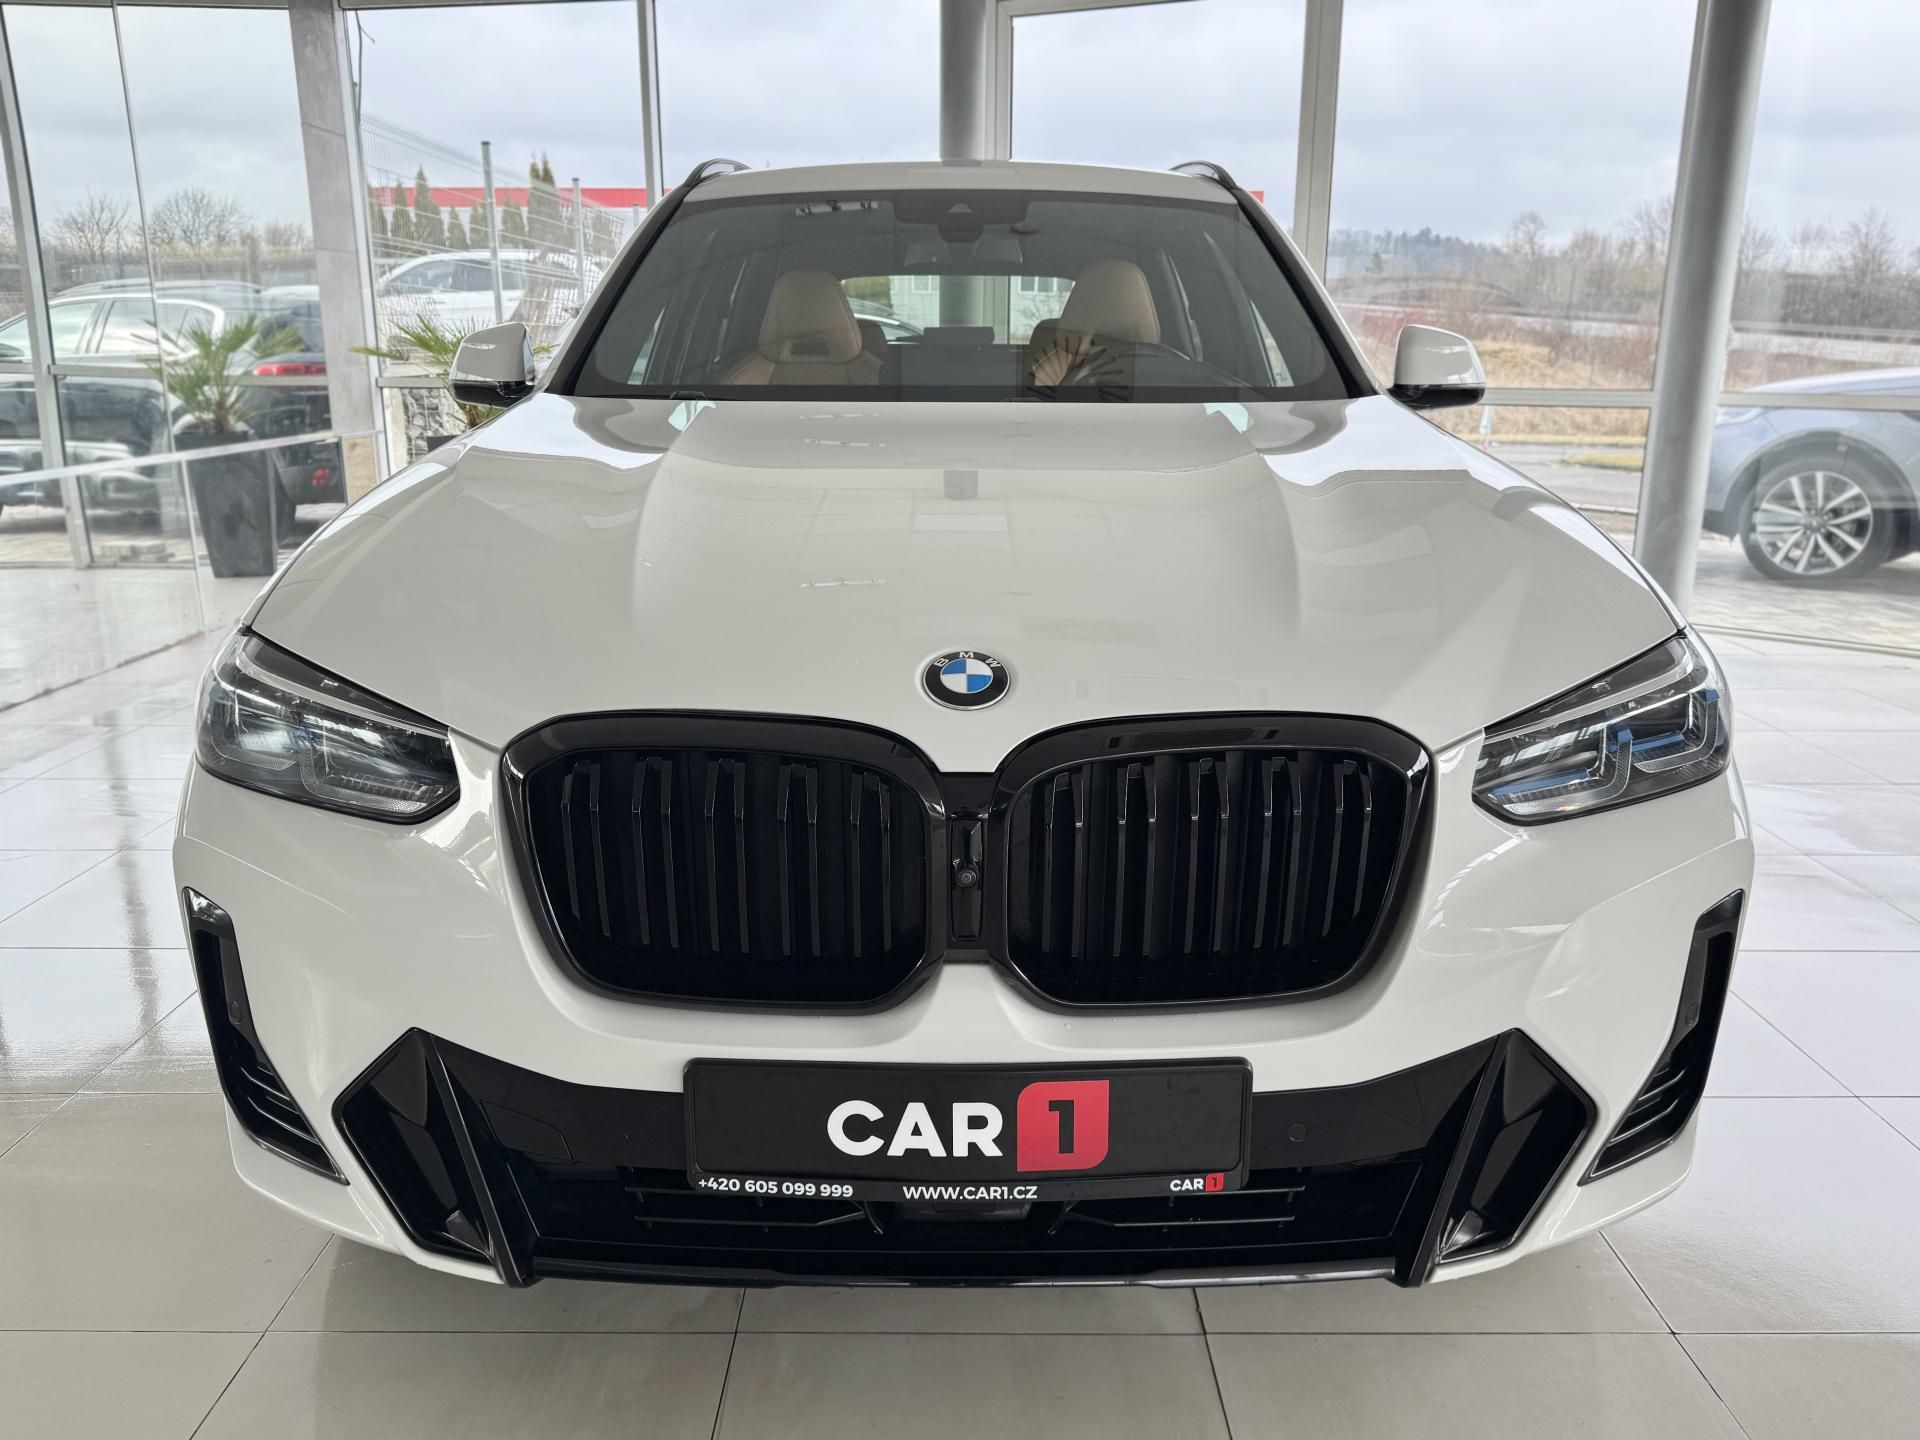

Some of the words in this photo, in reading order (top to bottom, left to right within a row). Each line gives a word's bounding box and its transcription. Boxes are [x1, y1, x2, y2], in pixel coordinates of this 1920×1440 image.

[933, 651, 1001, 668] BMW
[827, 1100, 1003, 1157] CAR
[1048, 1099, 1075, 1154] 1
[698, 1177, 740, 1192] +420
[744, 1180, 778, 1194] 605
[782, 1182, 816, 1196] 099
[820, 1184, 854, 1198] 999
[902, 1185, 1038, 1200] WWW.CAR1.CZ
[1169, 1178, 1204, 1192] CAR
